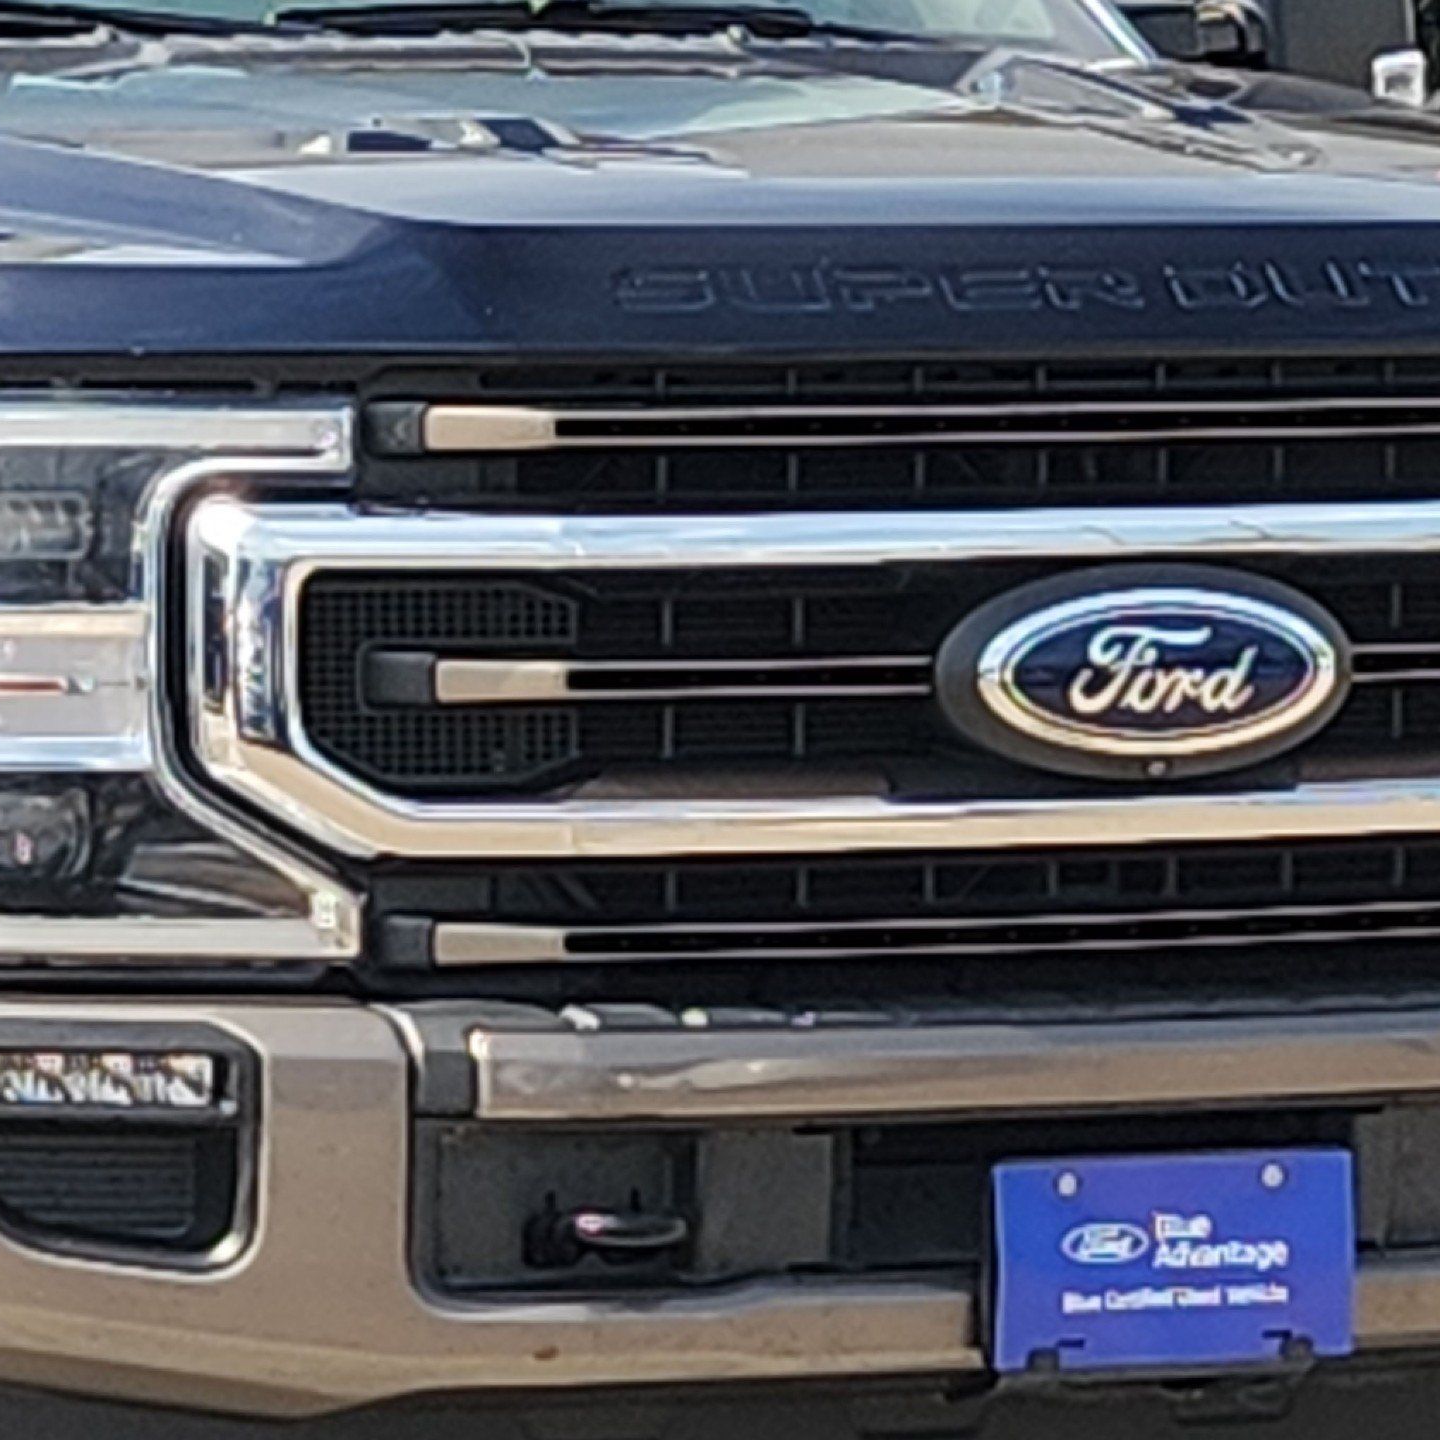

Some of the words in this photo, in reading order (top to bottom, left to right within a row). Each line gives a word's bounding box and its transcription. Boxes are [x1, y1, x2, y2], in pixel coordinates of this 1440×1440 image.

[610, 264, 1142, 315] SUPER
[1066, 623, 1259, 716] Ford
[1152, 1239, 1290, 1271] Advantage
